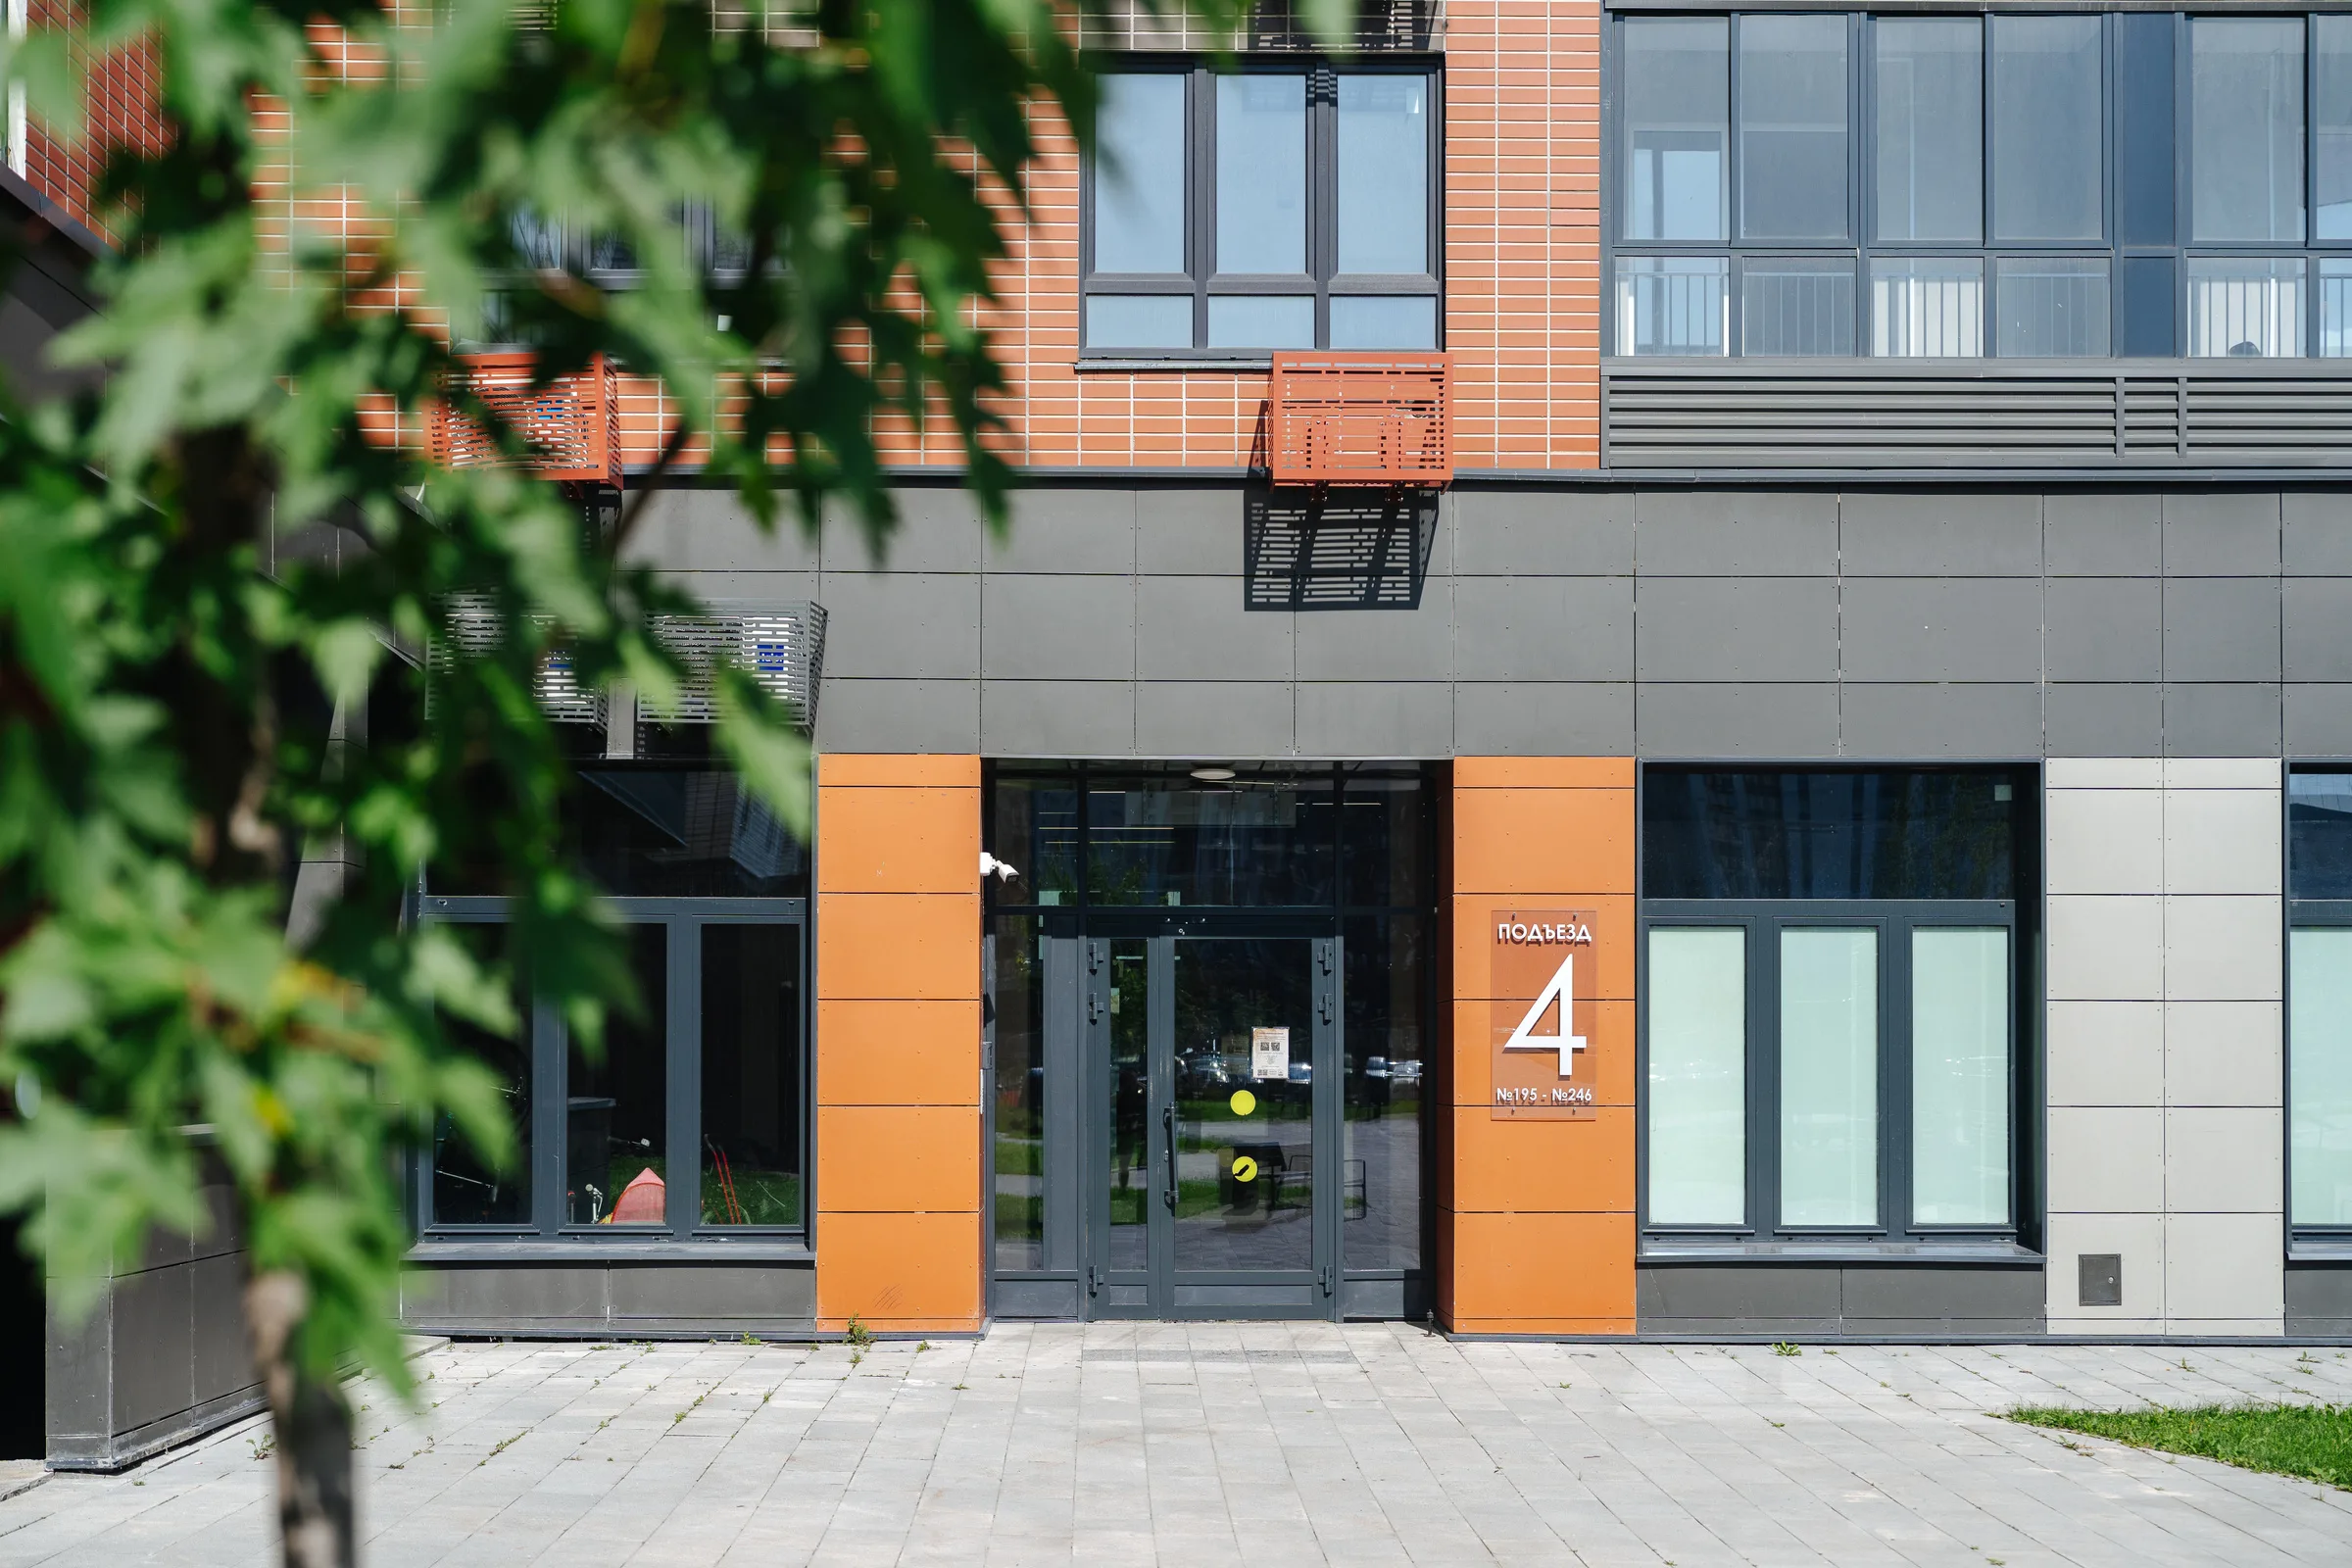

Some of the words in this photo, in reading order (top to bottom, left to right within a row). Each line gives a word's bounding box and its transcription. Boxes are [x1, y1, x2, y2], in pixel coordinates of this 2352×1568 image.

[1497, 923, 1592, 942] ПОДЪЕЗД
[1503, 953, 1588, 1076] 4
[1496, 1087, 1538, 1102] №195
[1551, 1088, 1592, 1102] №246
